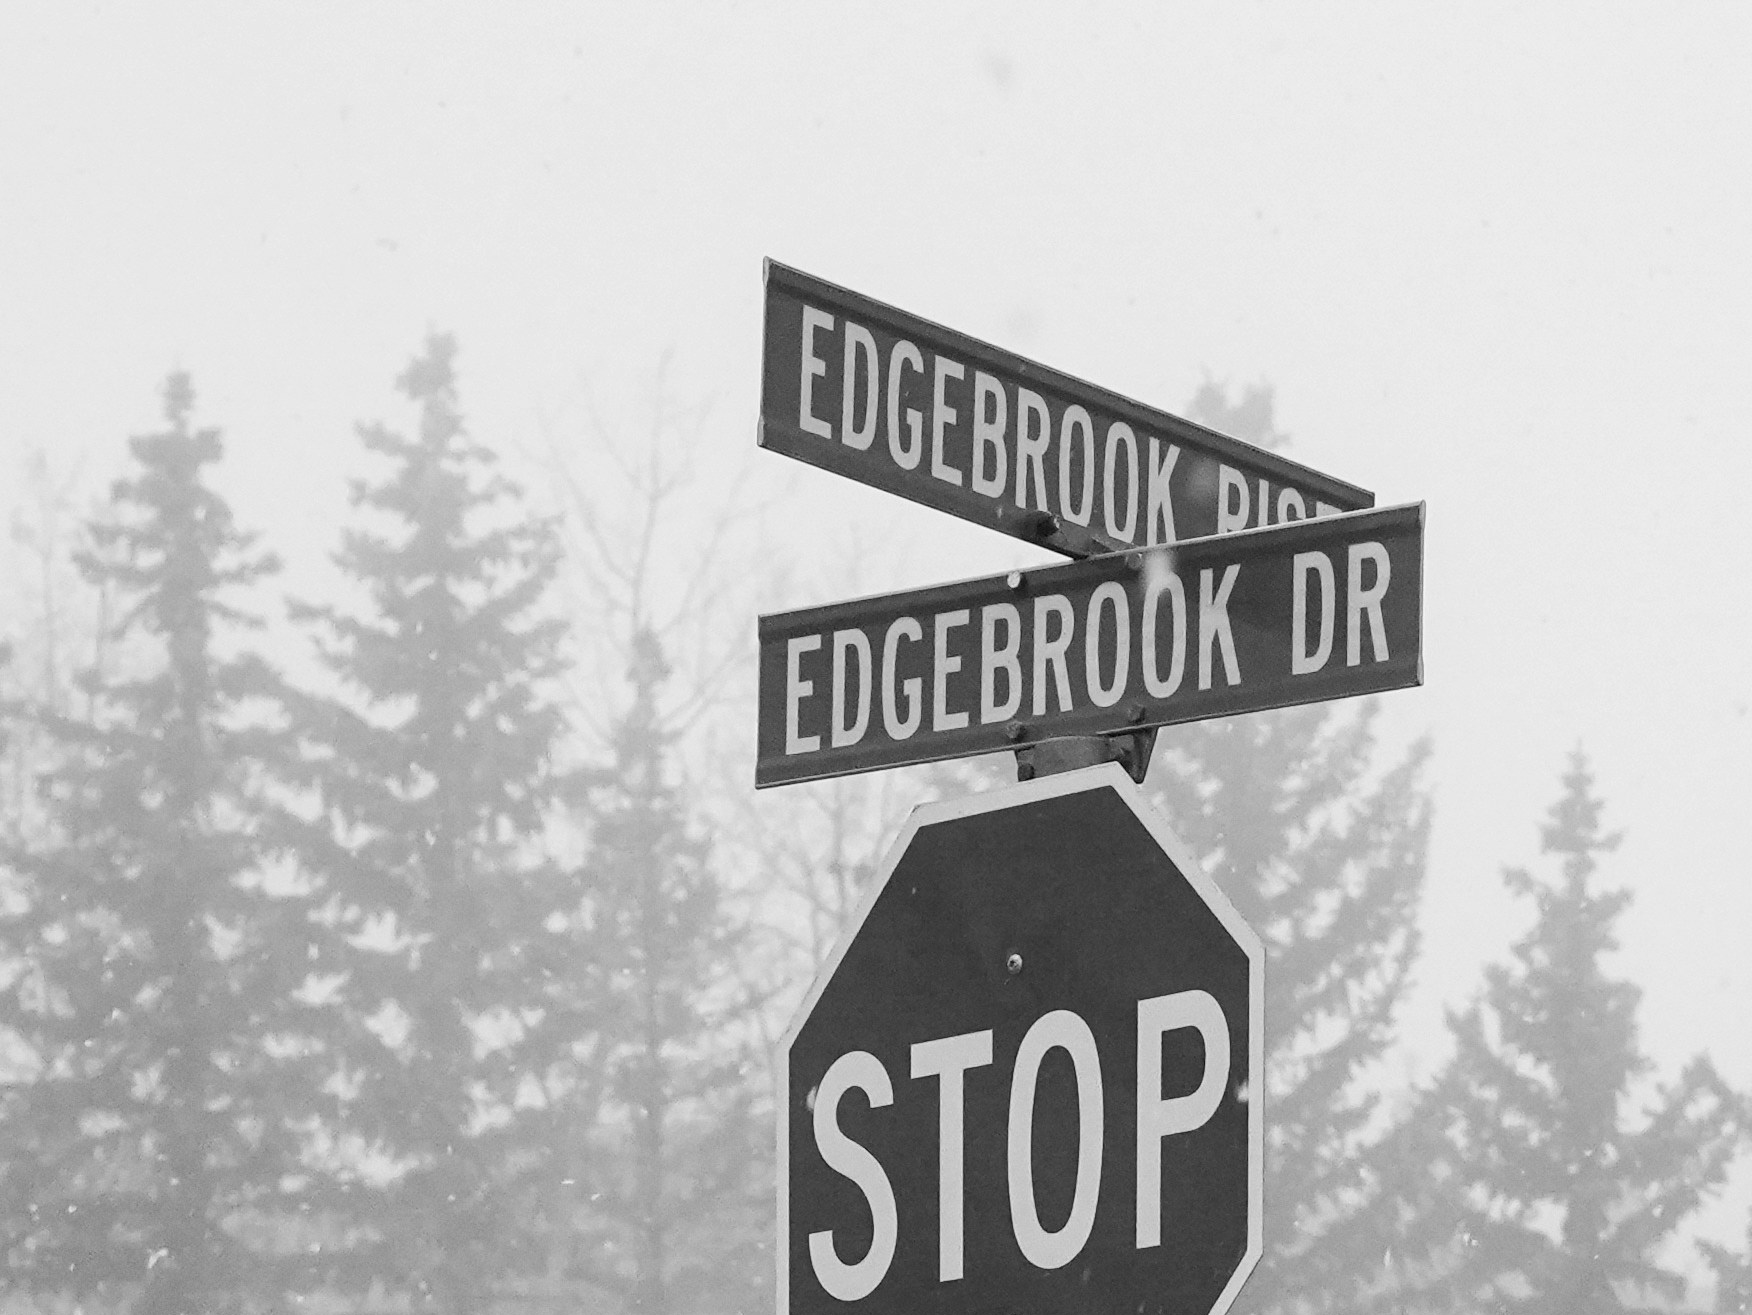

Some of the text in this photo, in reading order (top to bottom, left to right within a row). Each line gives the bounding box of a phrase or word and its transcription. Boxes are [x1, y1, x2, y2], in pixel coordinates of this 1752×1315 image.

[799, 304, 1181, 547] EDGEBROOK
[784, 541, 1392, 756] EDGEBROOK DR
[808, 989, 1231, 1302] STOP
